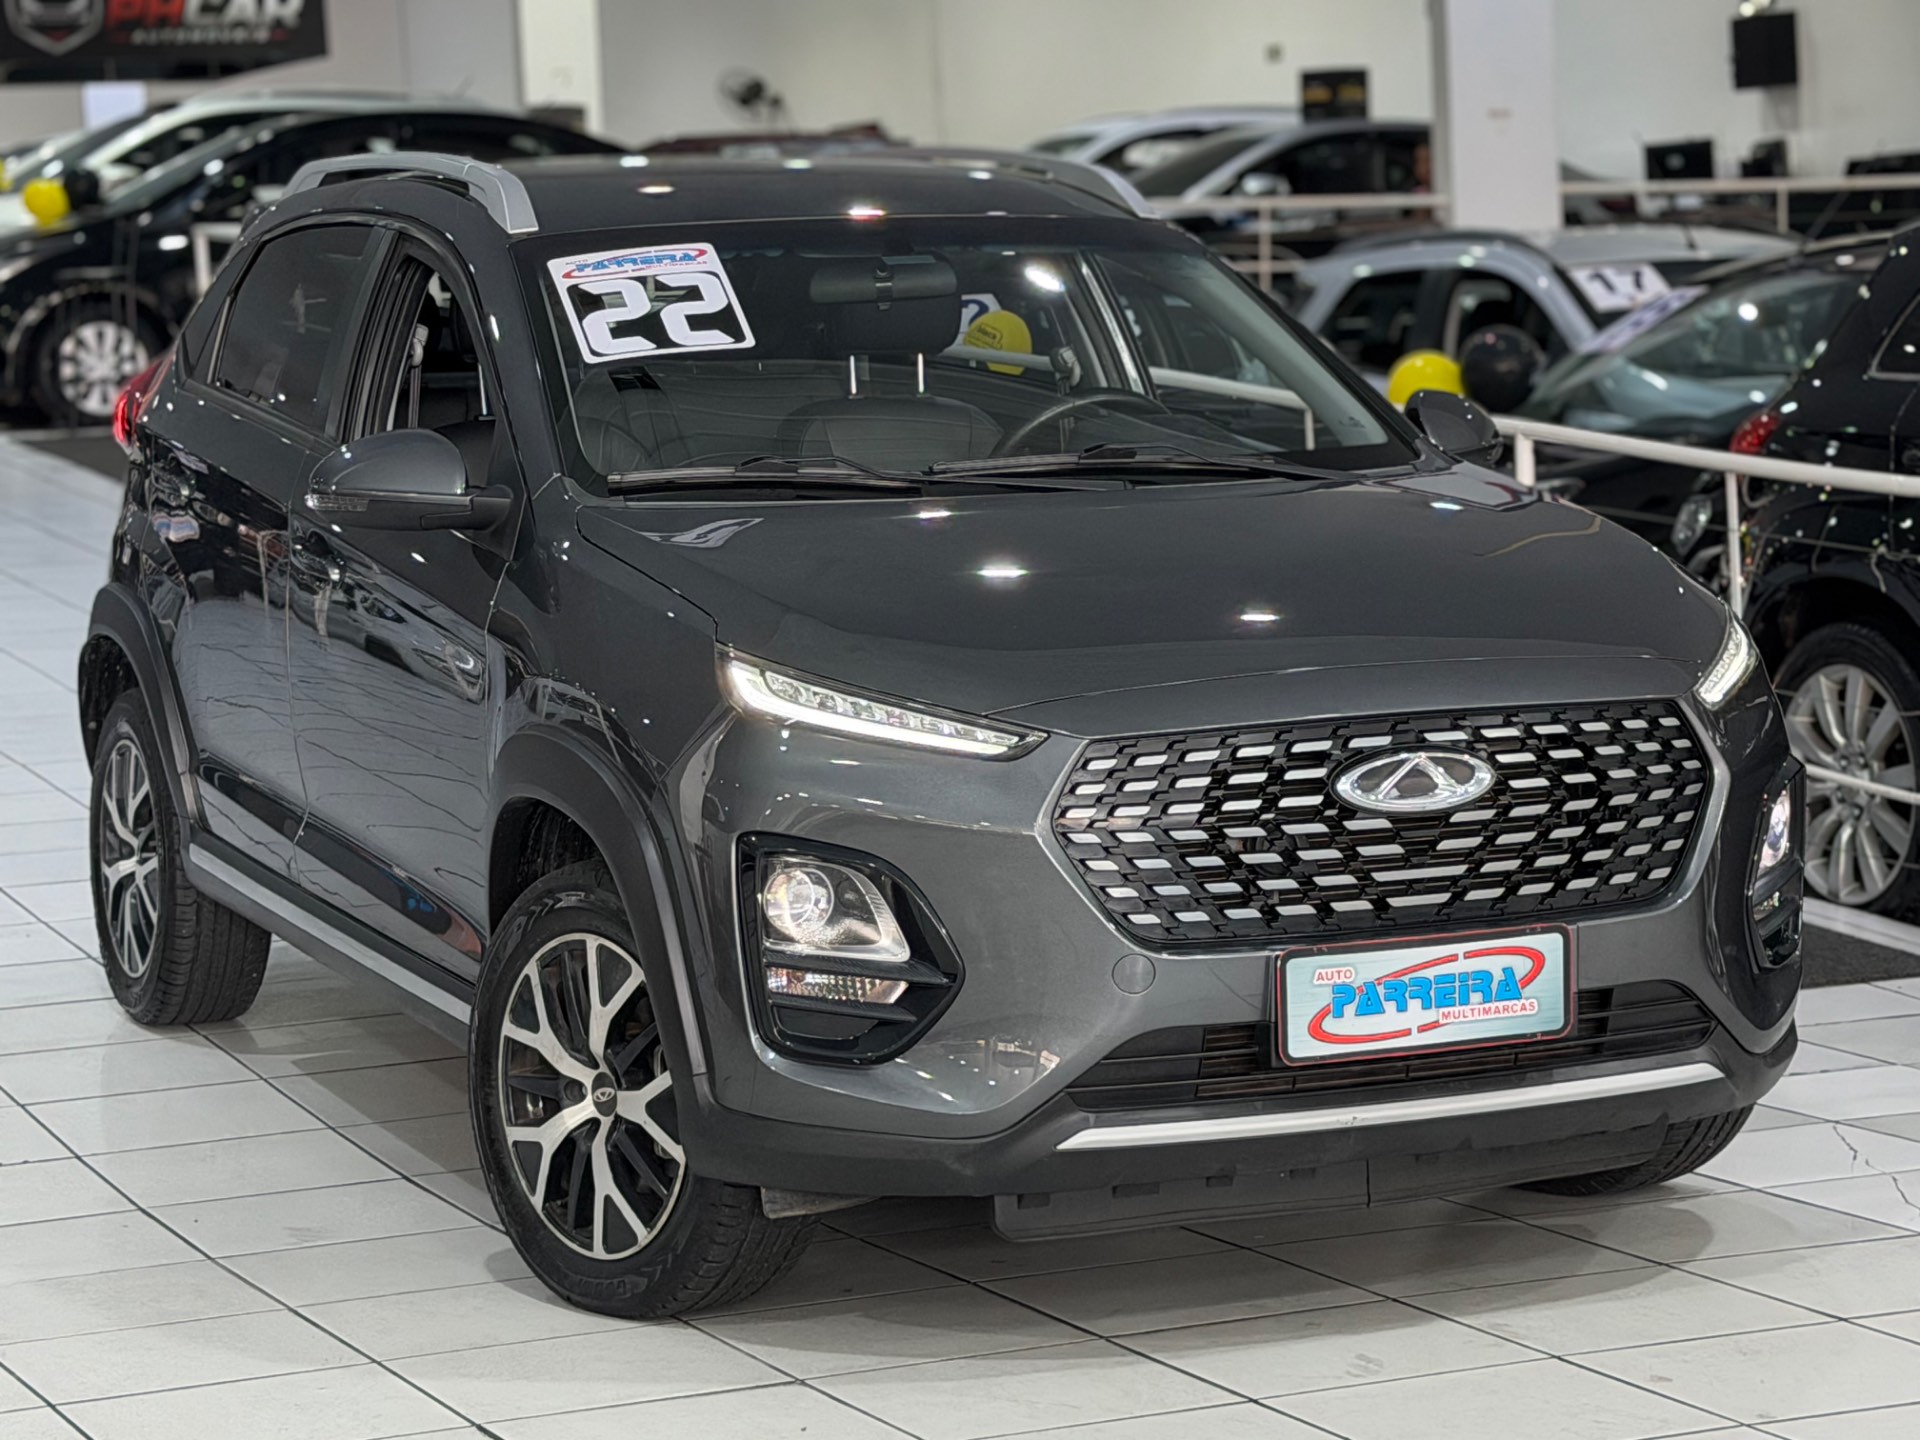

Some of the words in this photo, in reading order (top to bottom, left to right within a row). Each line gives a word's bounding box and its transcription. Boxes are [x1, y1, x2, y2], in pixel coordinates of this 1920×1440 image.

[576, 252, 697, 272] PARREIRA
[578, 272, 735, 354] 22
[1315, 968, 1354, 982] AUTO
[1332, 967, 1523, 1018] PARREIRA
[1440, 1001, 1537, 1021] MULTIMARCAS
